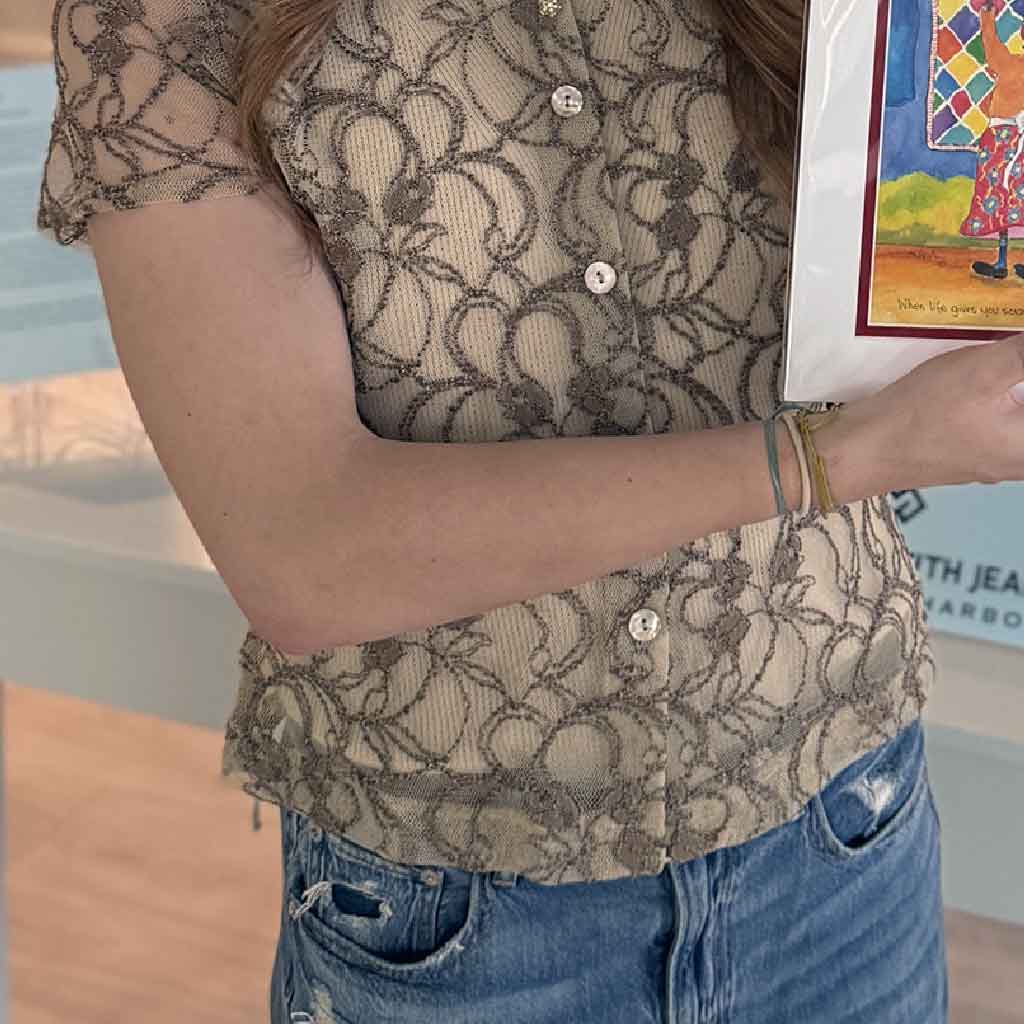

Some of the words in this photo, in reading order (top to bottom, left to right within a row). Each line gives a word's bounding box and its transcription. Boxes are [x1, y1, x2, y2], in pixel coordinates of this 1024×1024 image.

[897, 296, 925, 312] When
[951, 303, 977, 318] gives
[980, 304, 999, 318] you
[910, 551, 963, 584] ITH
